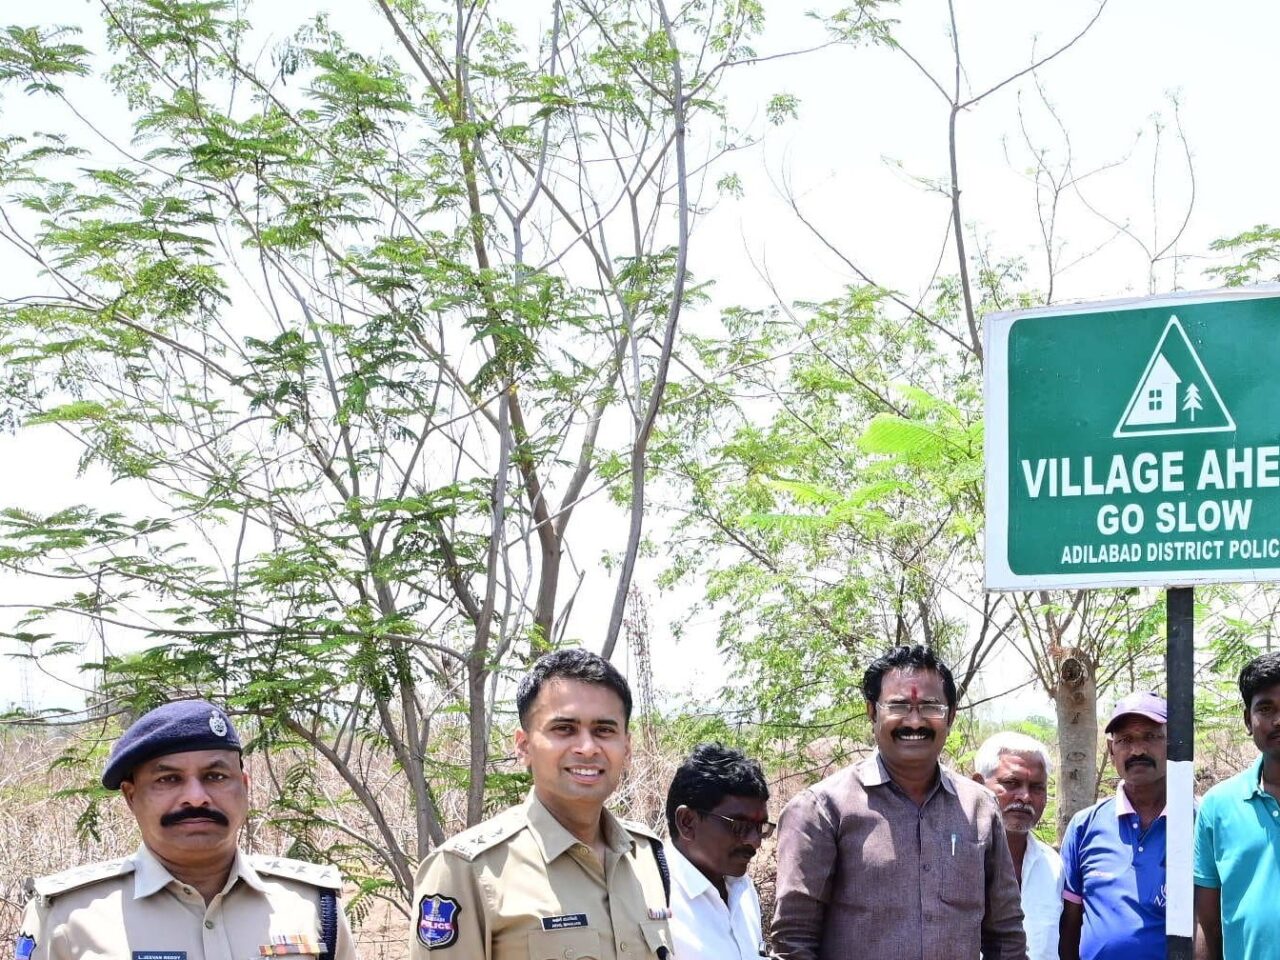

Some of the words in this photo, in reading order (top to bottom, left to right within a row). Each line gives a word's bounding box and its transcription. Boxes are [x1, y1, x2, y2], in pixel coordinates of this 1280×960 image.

[1021, 450, 1185, 498] VILLAGE
[1096, 503, 1145, 536] GO
[1155, 498, 1253, 534] SLOW
[1061, 543, 1142, 564] ADILABAD
[1147, 540, 1225, 562] DISTRICT
[420, 919, 452, 930] POLICE
